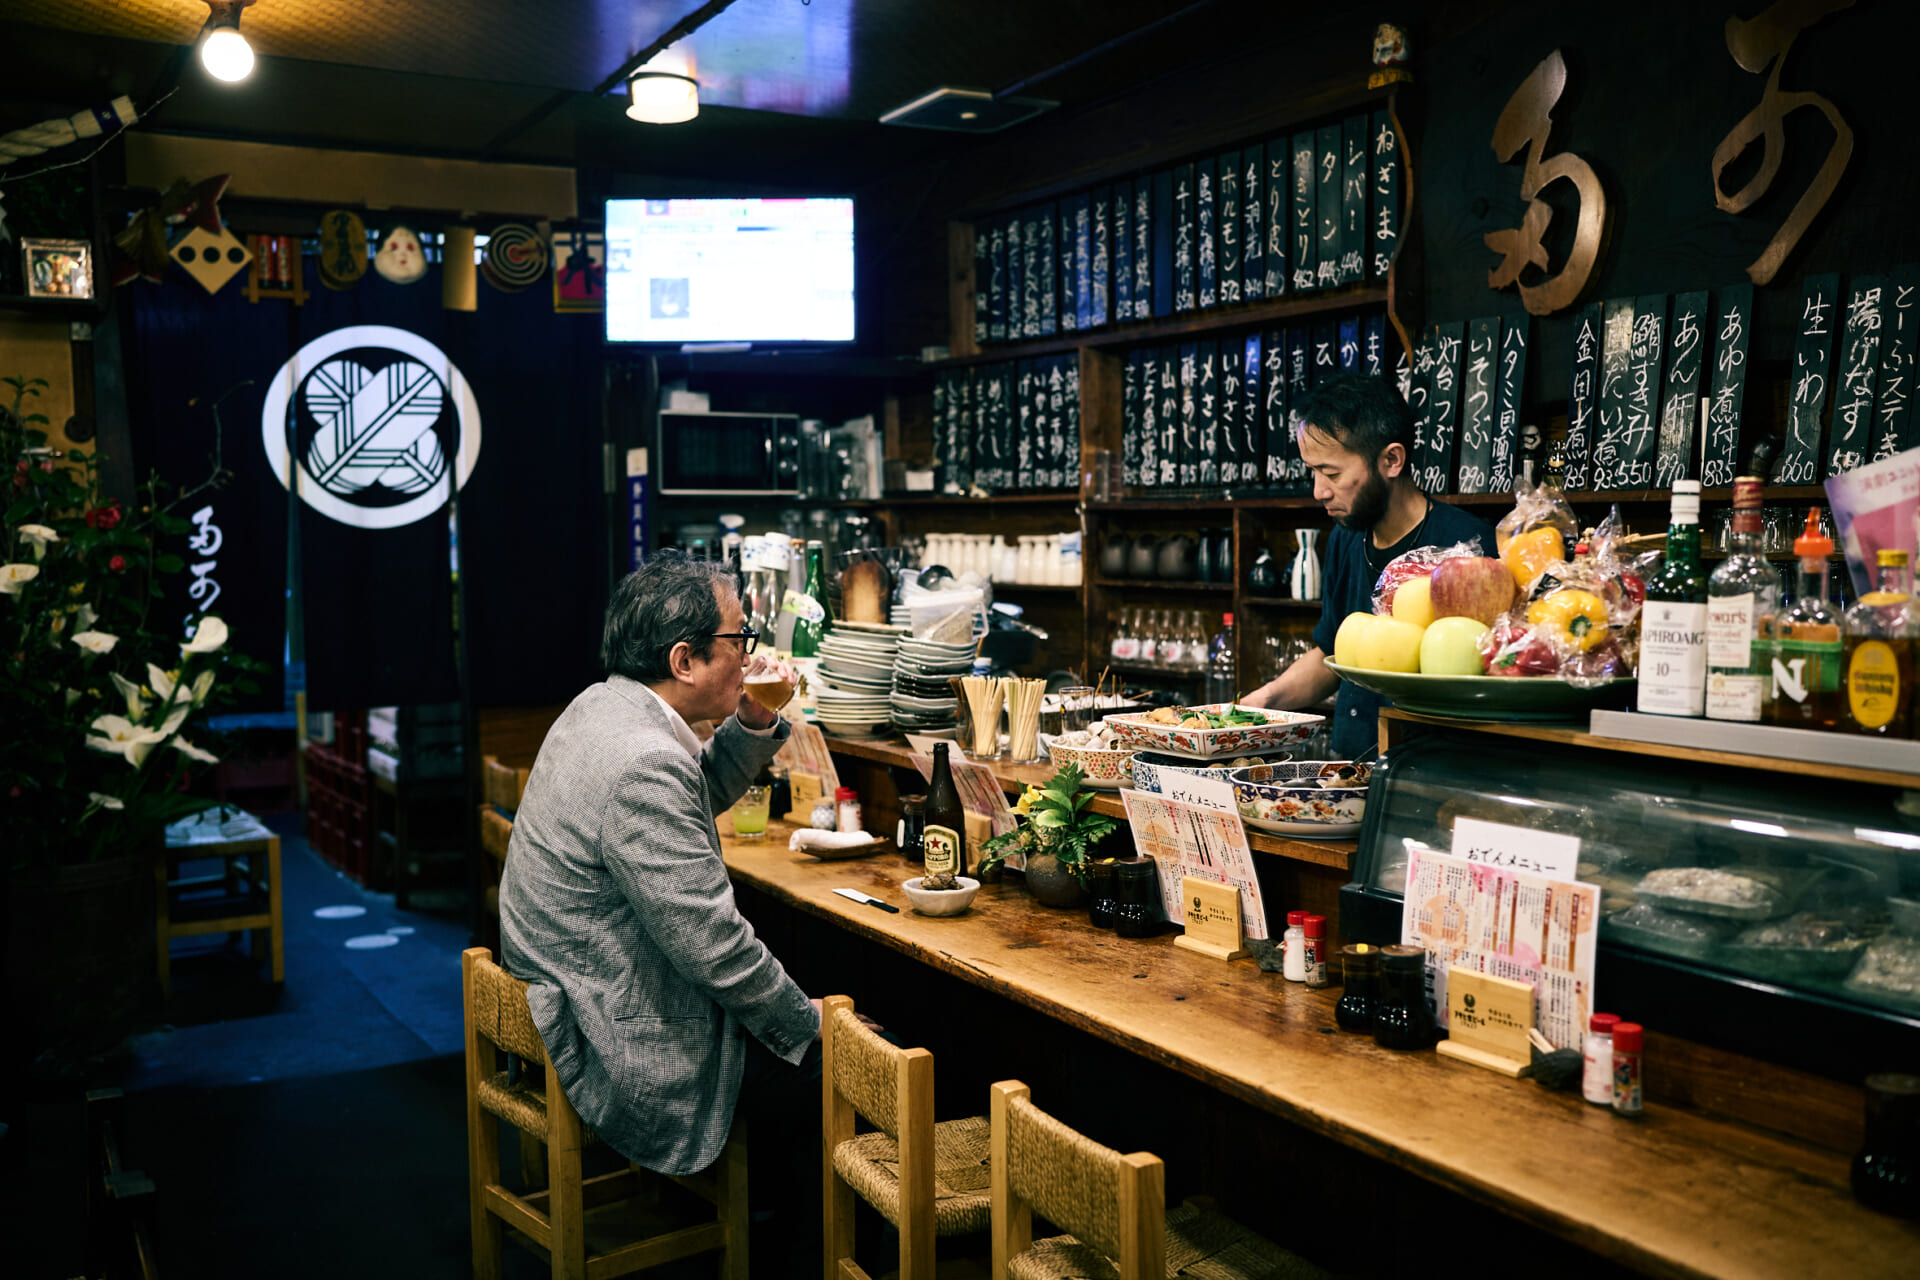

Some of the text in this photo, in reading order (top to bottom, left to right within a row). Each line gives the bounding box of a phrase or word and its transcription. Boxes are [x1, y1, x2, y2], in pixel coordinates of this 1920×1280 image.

[1221, 165, 1238, 272] ホルモン
[1244, 162, 1262, 263] 手羽先
[1268, 159, 1286, 258] とり皮
[1293, 150, 1315, 290] やきとり 462
[1322, 151, 1337, 241] タン
[1374, 123, 1396, 276] ねぎま 50
[1062, 216, 1074, 304] トマト
[1161, 361, 1177, 454] 山かけ
[1223, 353, 1240, 453] いかさし
[1244, 347, 1257, 453] たこさし
[1265, 347, 1283, 431] 石だい
[1565, 318, 1596, 460] 金目煮
[1656, 311, 1700, 488] あん肝 990
[1781, 292, 1832, 483] 生いわし 660
[1838, 286, 1882, 441] 揚げなす
[1425, 335, 1462, 494] 灯台つぶ 990
[1459, 336, 1492, 492] いそつぶ 990
[1615, 459, 1653, 486] 550
[1656, 661, 1670, 677] 10
[1771, 657, 1809, 704] N
[1172, 789, 1227, 810] おでんメニュー
[1467, 847, 1557, 873] おでんメニュー
